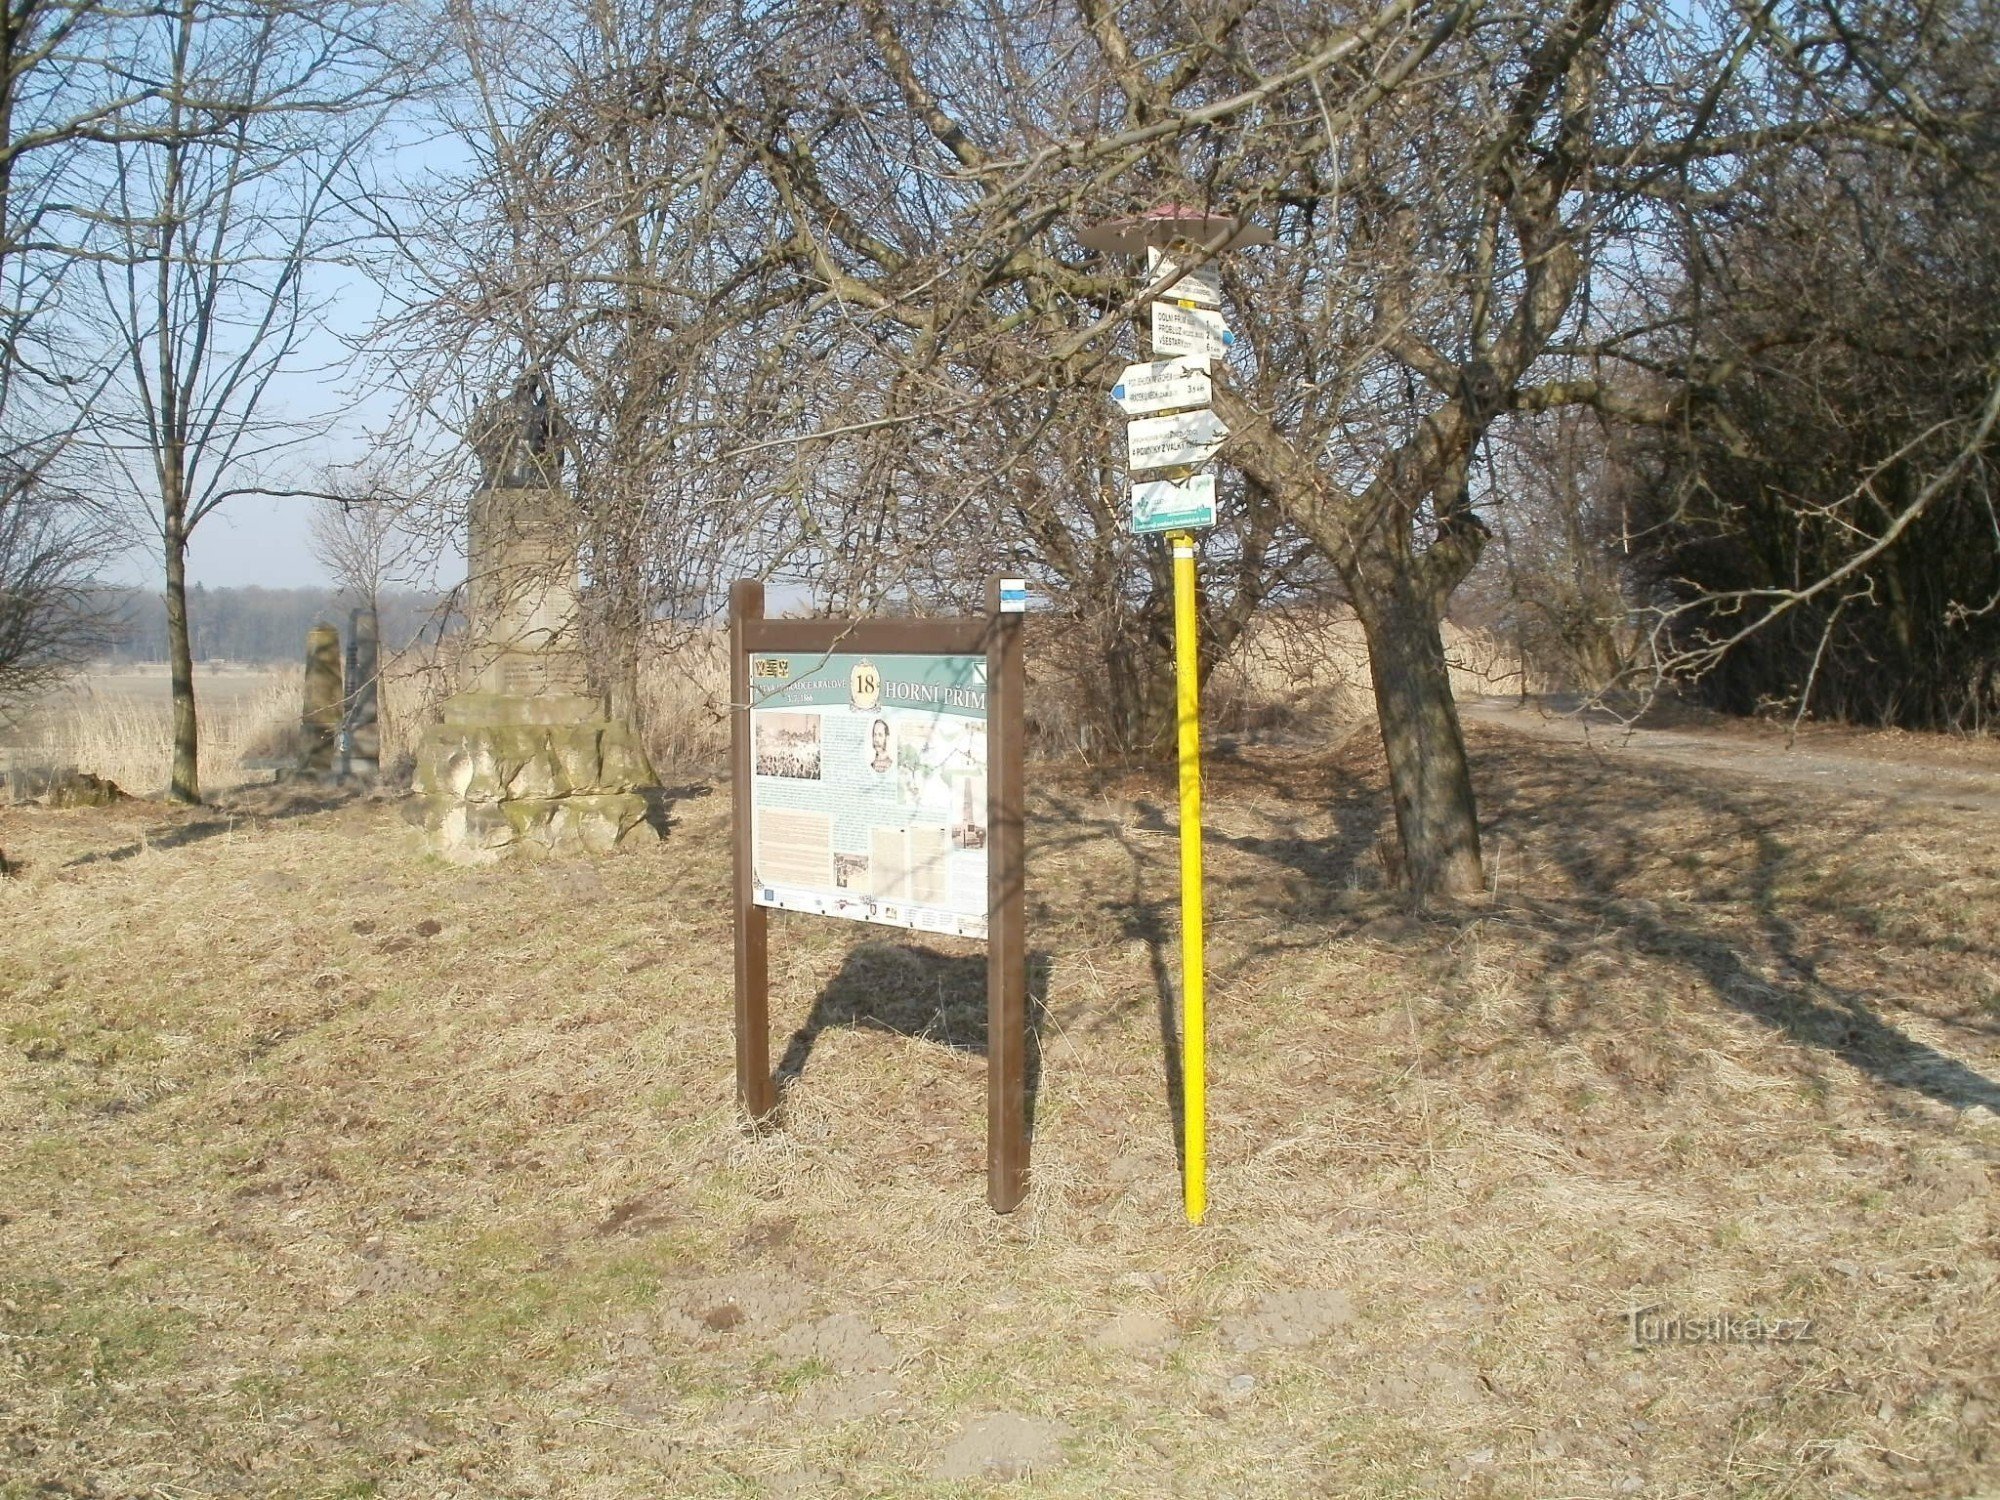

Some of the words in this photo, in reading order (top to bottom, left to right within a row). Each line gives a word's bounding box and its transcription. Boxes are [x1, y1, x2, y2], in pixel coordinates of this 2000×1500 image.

[856, 674, 876, 694] 18
[885, 681, 941, 703] HORNÍ
[944, 683, 986, 710] PŘÍM
